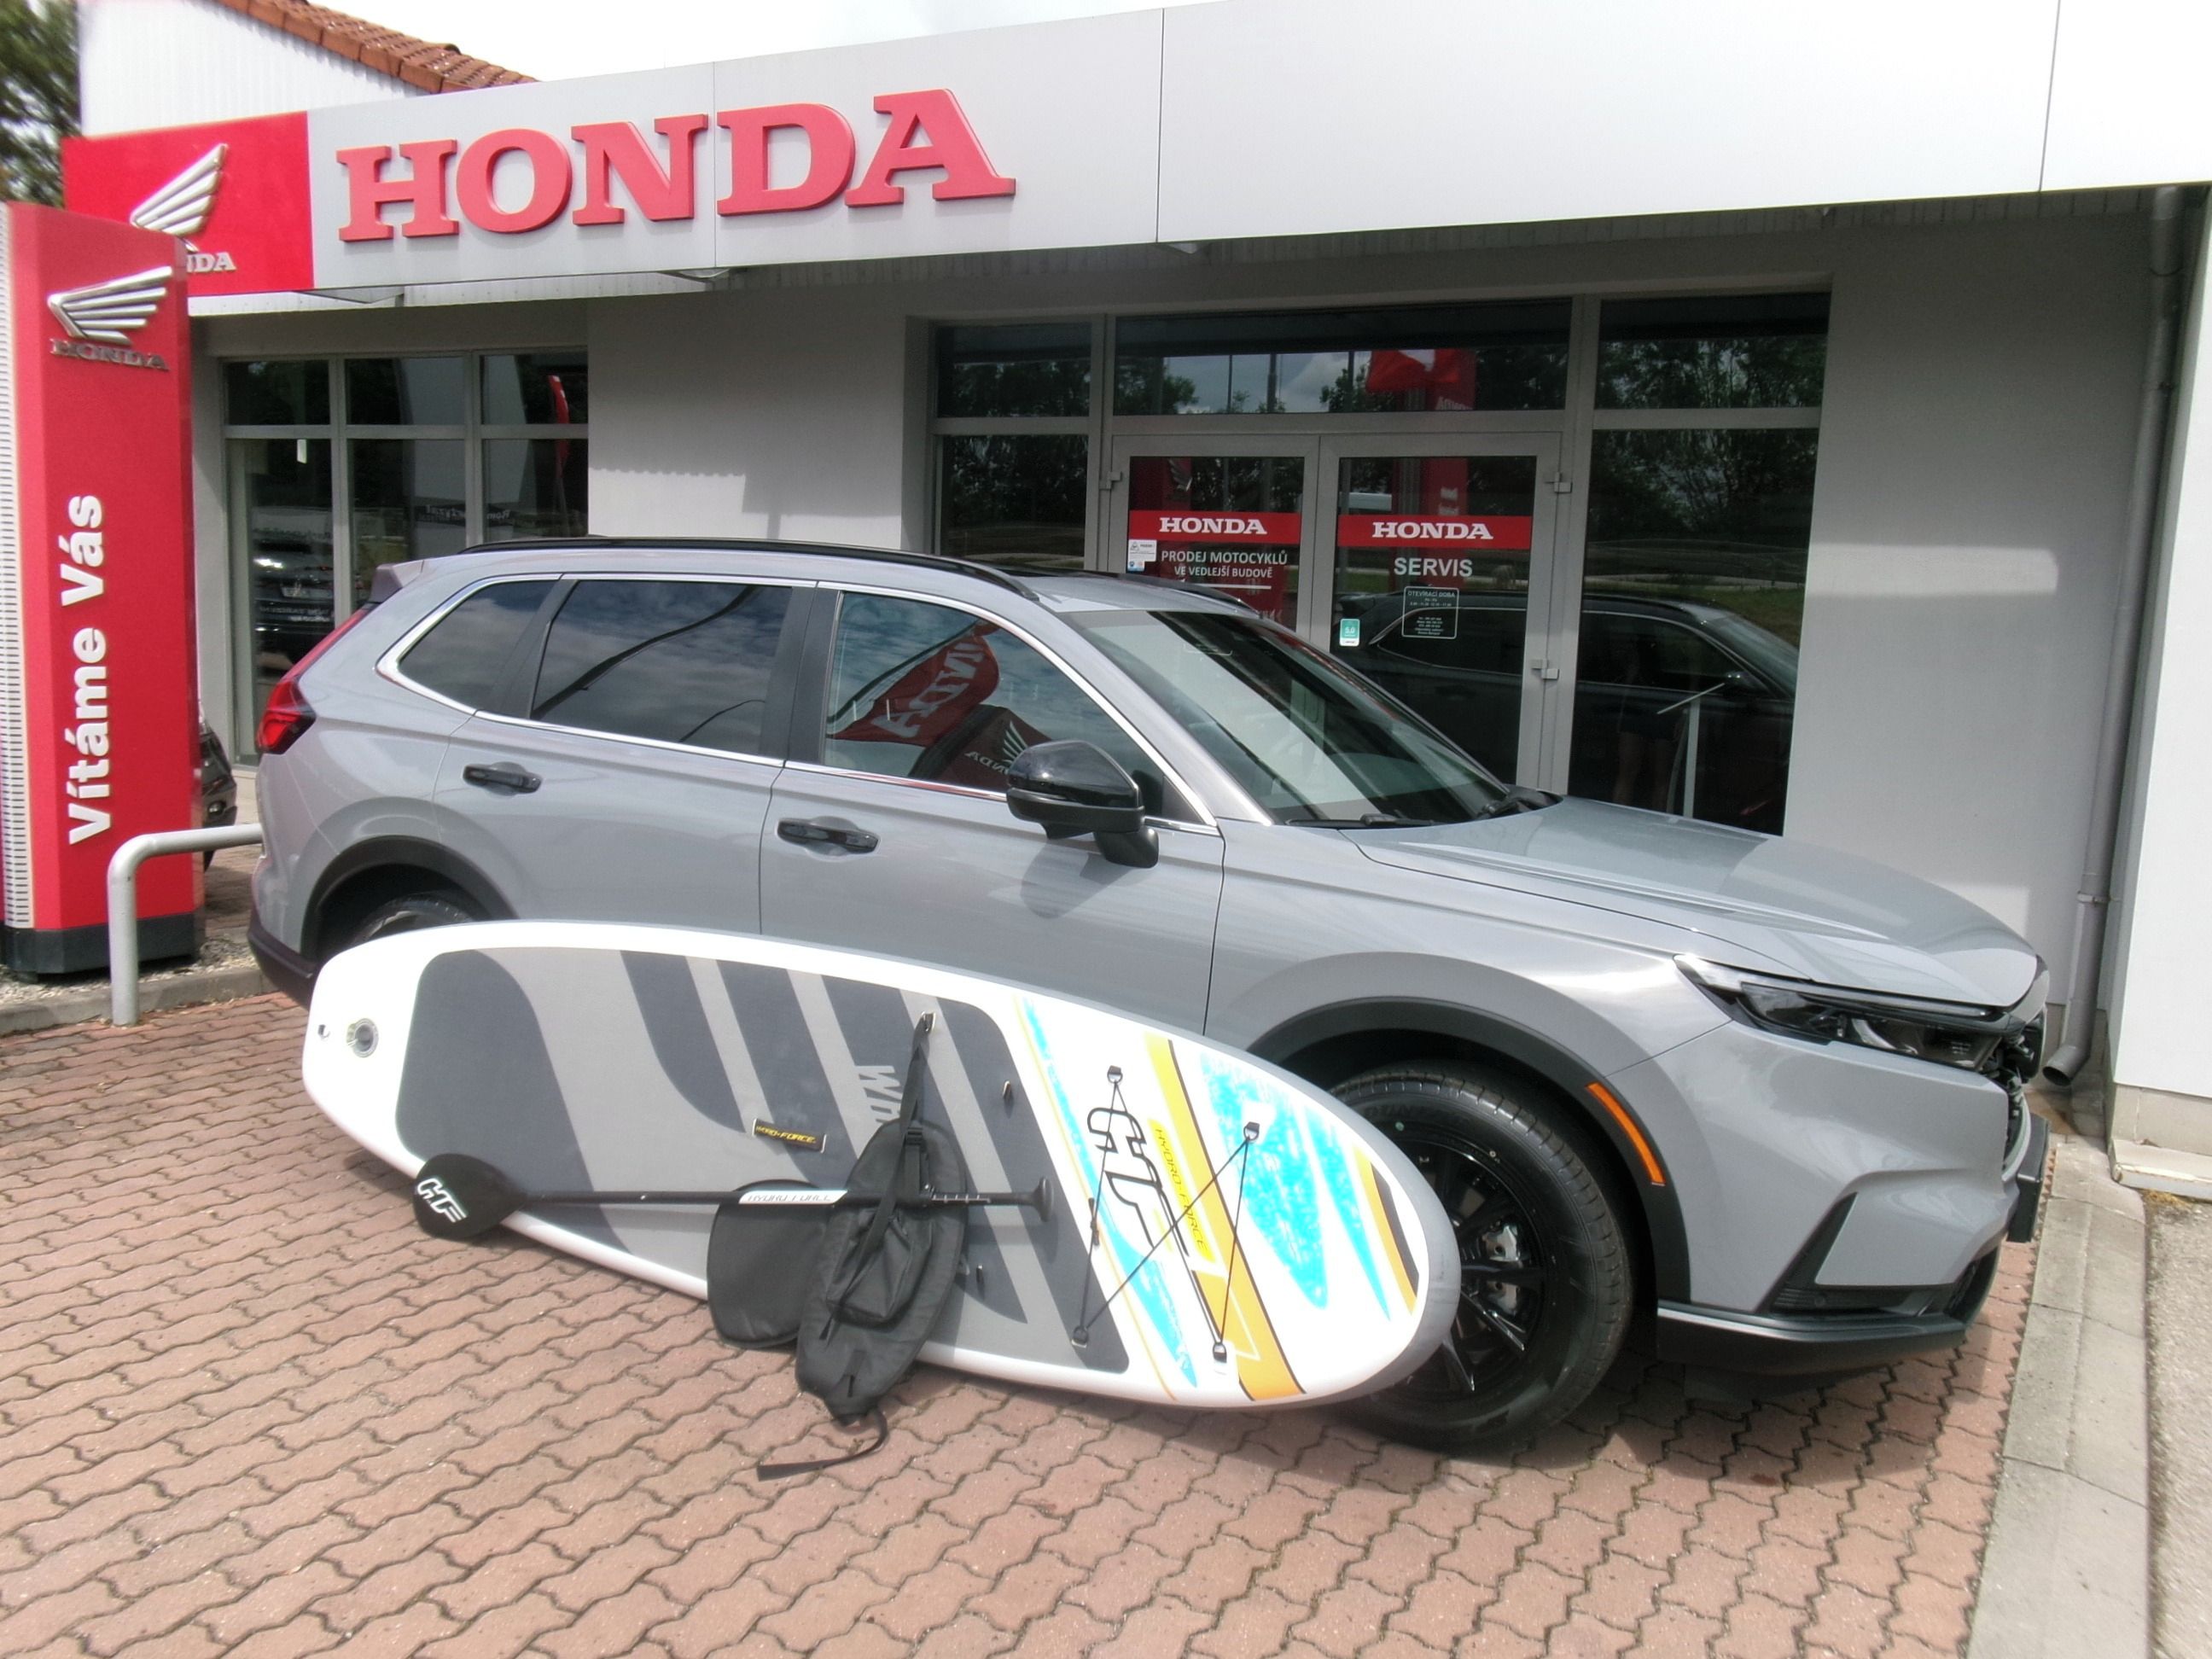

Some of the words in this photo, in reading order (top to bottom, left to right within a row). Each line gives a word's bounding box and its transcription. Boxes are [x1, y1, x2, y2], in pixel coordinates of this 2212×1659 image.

[335, 88, 1016, 242] HONDA
[49, 338, 170, 370] HONDA
[1159, 517, 1267, 535] HONDA
[1372, 521, 1493, 539] HONDA
[59, 494, 106, 607] Vás
[1161, 550, 1207, 563] PRODEJ
[1210, 550, 1288, 565] MOTOCYKLŮ
[1174, 566, 1186, 576] VE
[1189, 565, 1231, 577] VEDLEJŠÍ
[1232, 566, 1273, 578] BUDOVĚ
[1394, 557, 1474, 577] SERVIS
[65, 627, 112, 845] Vítáme
